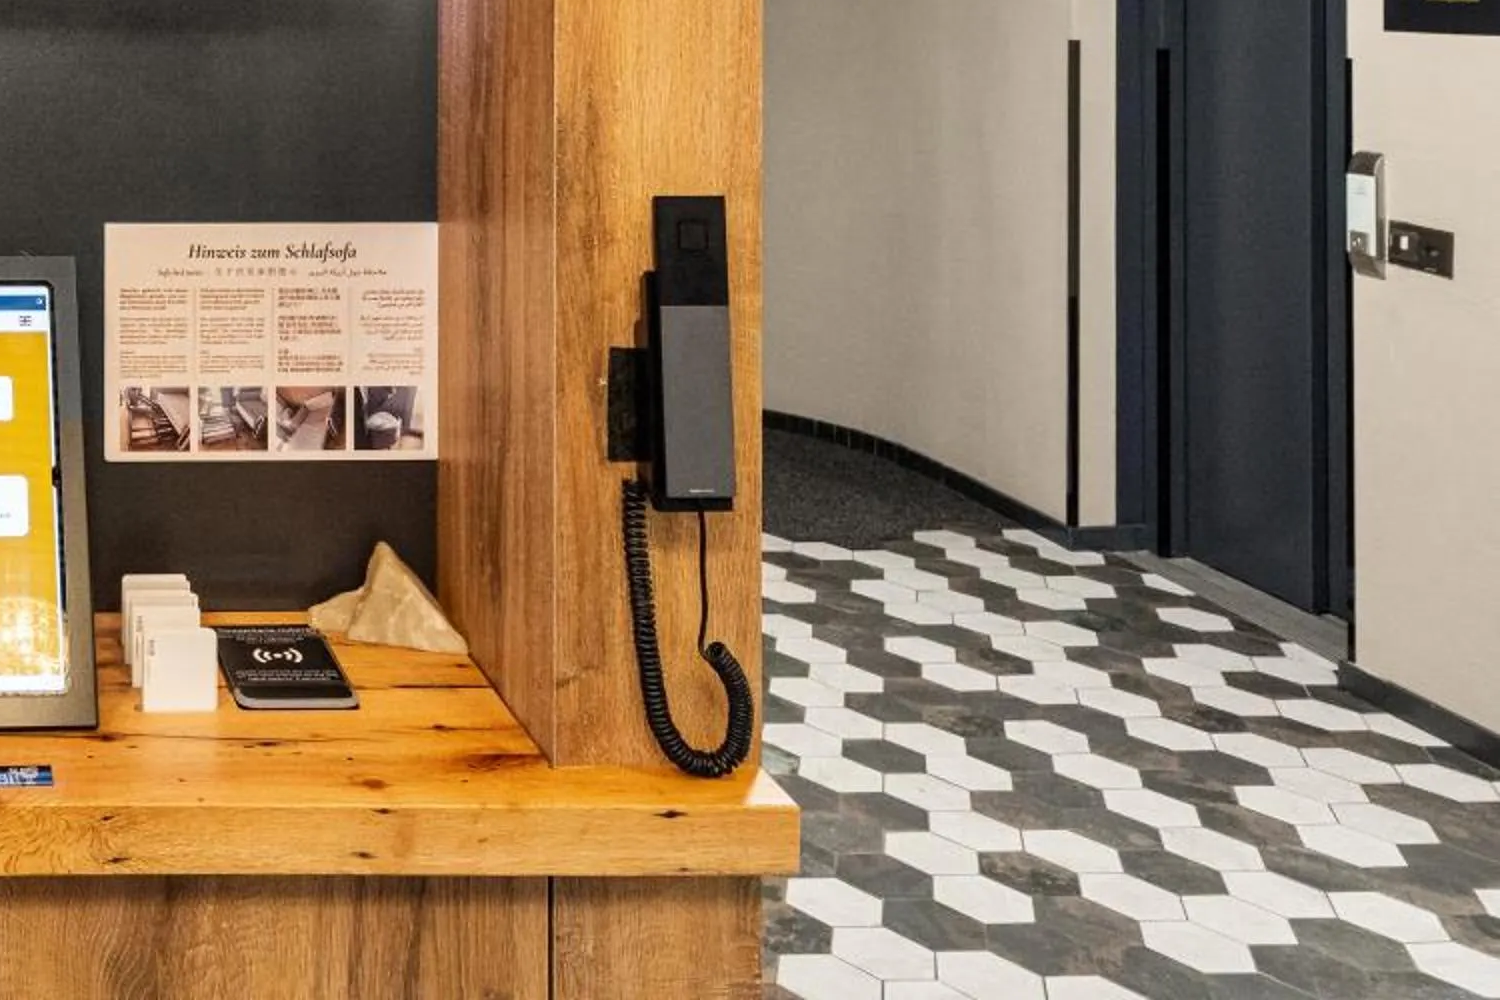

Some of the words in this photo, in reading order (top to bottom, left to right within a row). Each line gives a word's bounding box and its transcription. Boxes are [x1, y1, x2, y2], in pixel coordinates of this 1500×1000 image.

[188, 243, 247, 260] Hinweis
[250, 248, 281, 260] zum
[285, 239, 358, 263] Schlafsofa
